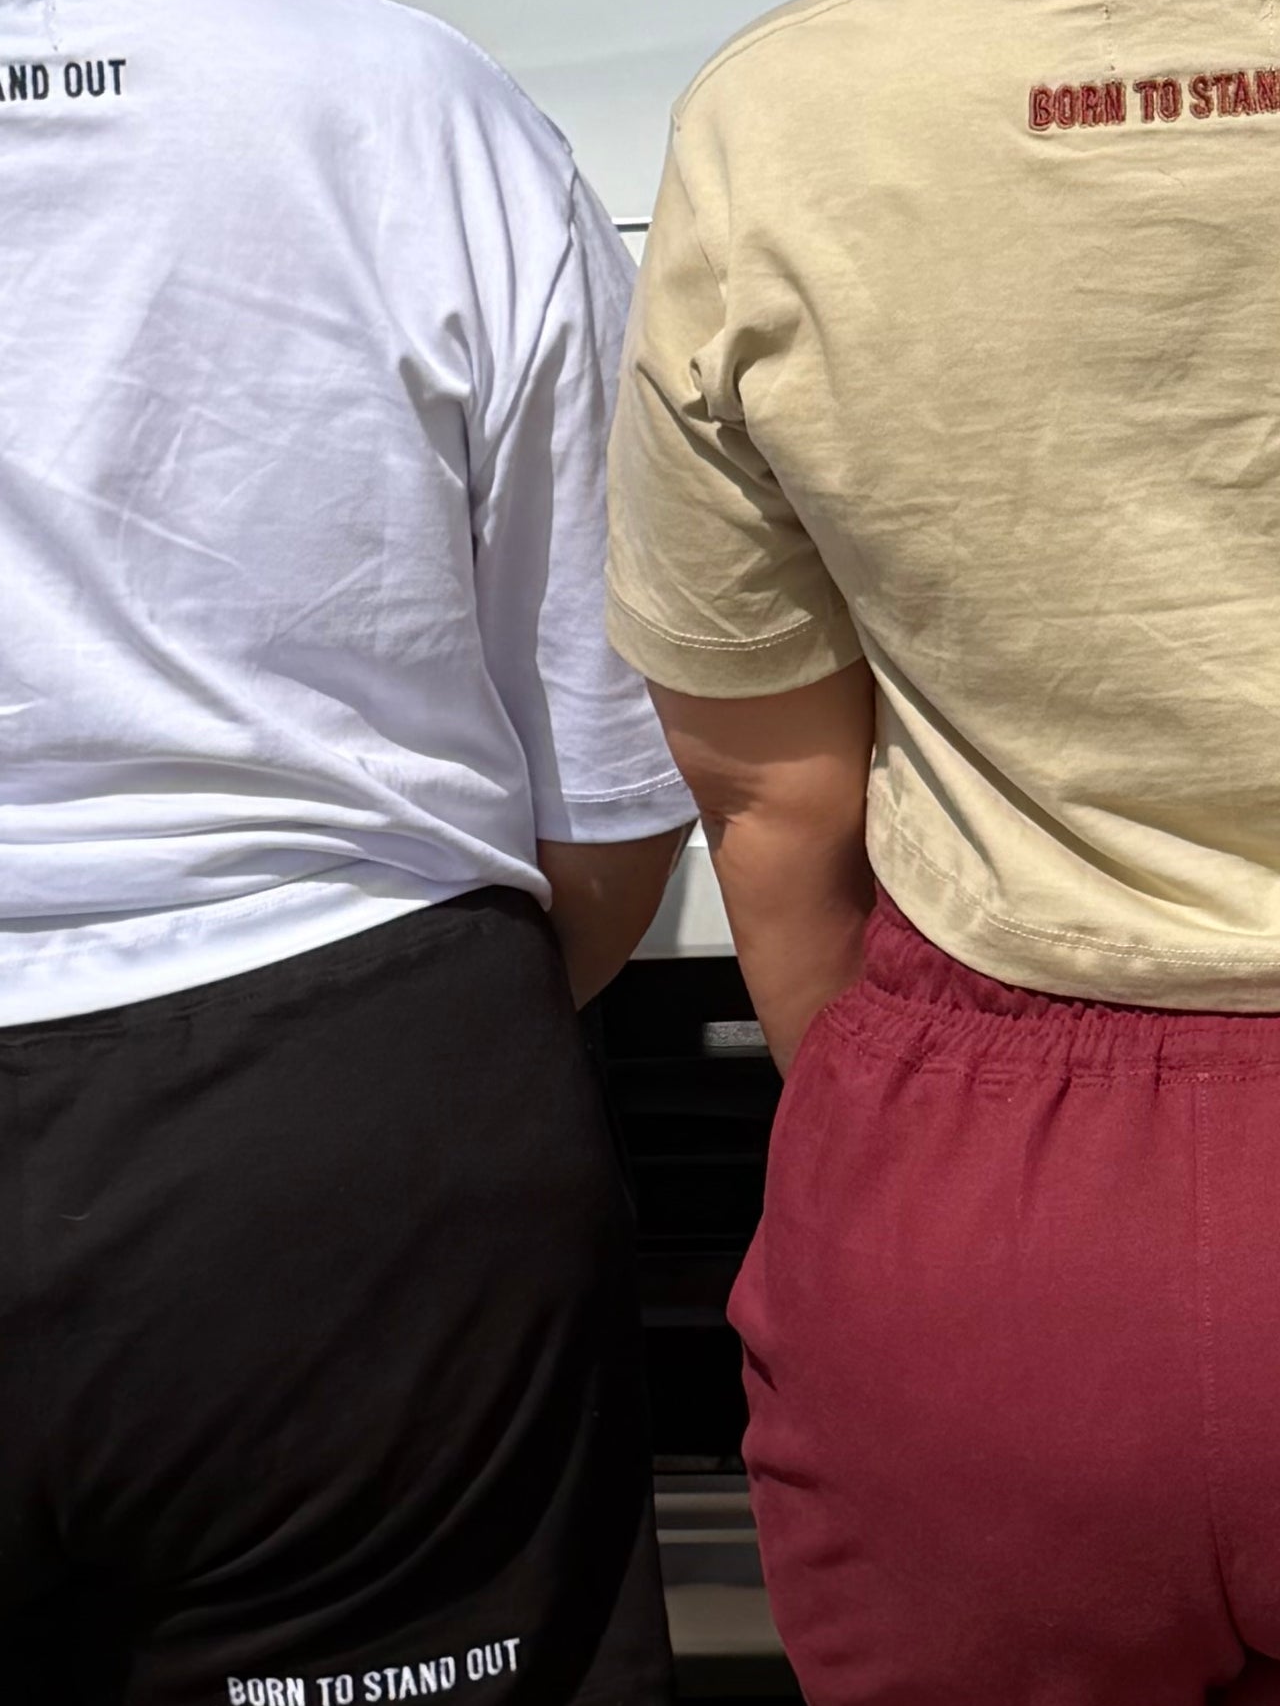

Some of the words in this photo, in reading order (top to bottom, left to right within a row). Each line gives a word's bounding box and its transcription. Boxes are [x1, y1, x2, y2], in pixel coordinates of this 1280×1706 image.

[64, 58, 127, 98] OUT
[1028, 82, 1127, 131] BORN
[1133, 76, 1182, 124] TO
[363, 1655, 456, 1702] STAND
[466, 1636, 521, 1681] OUT
